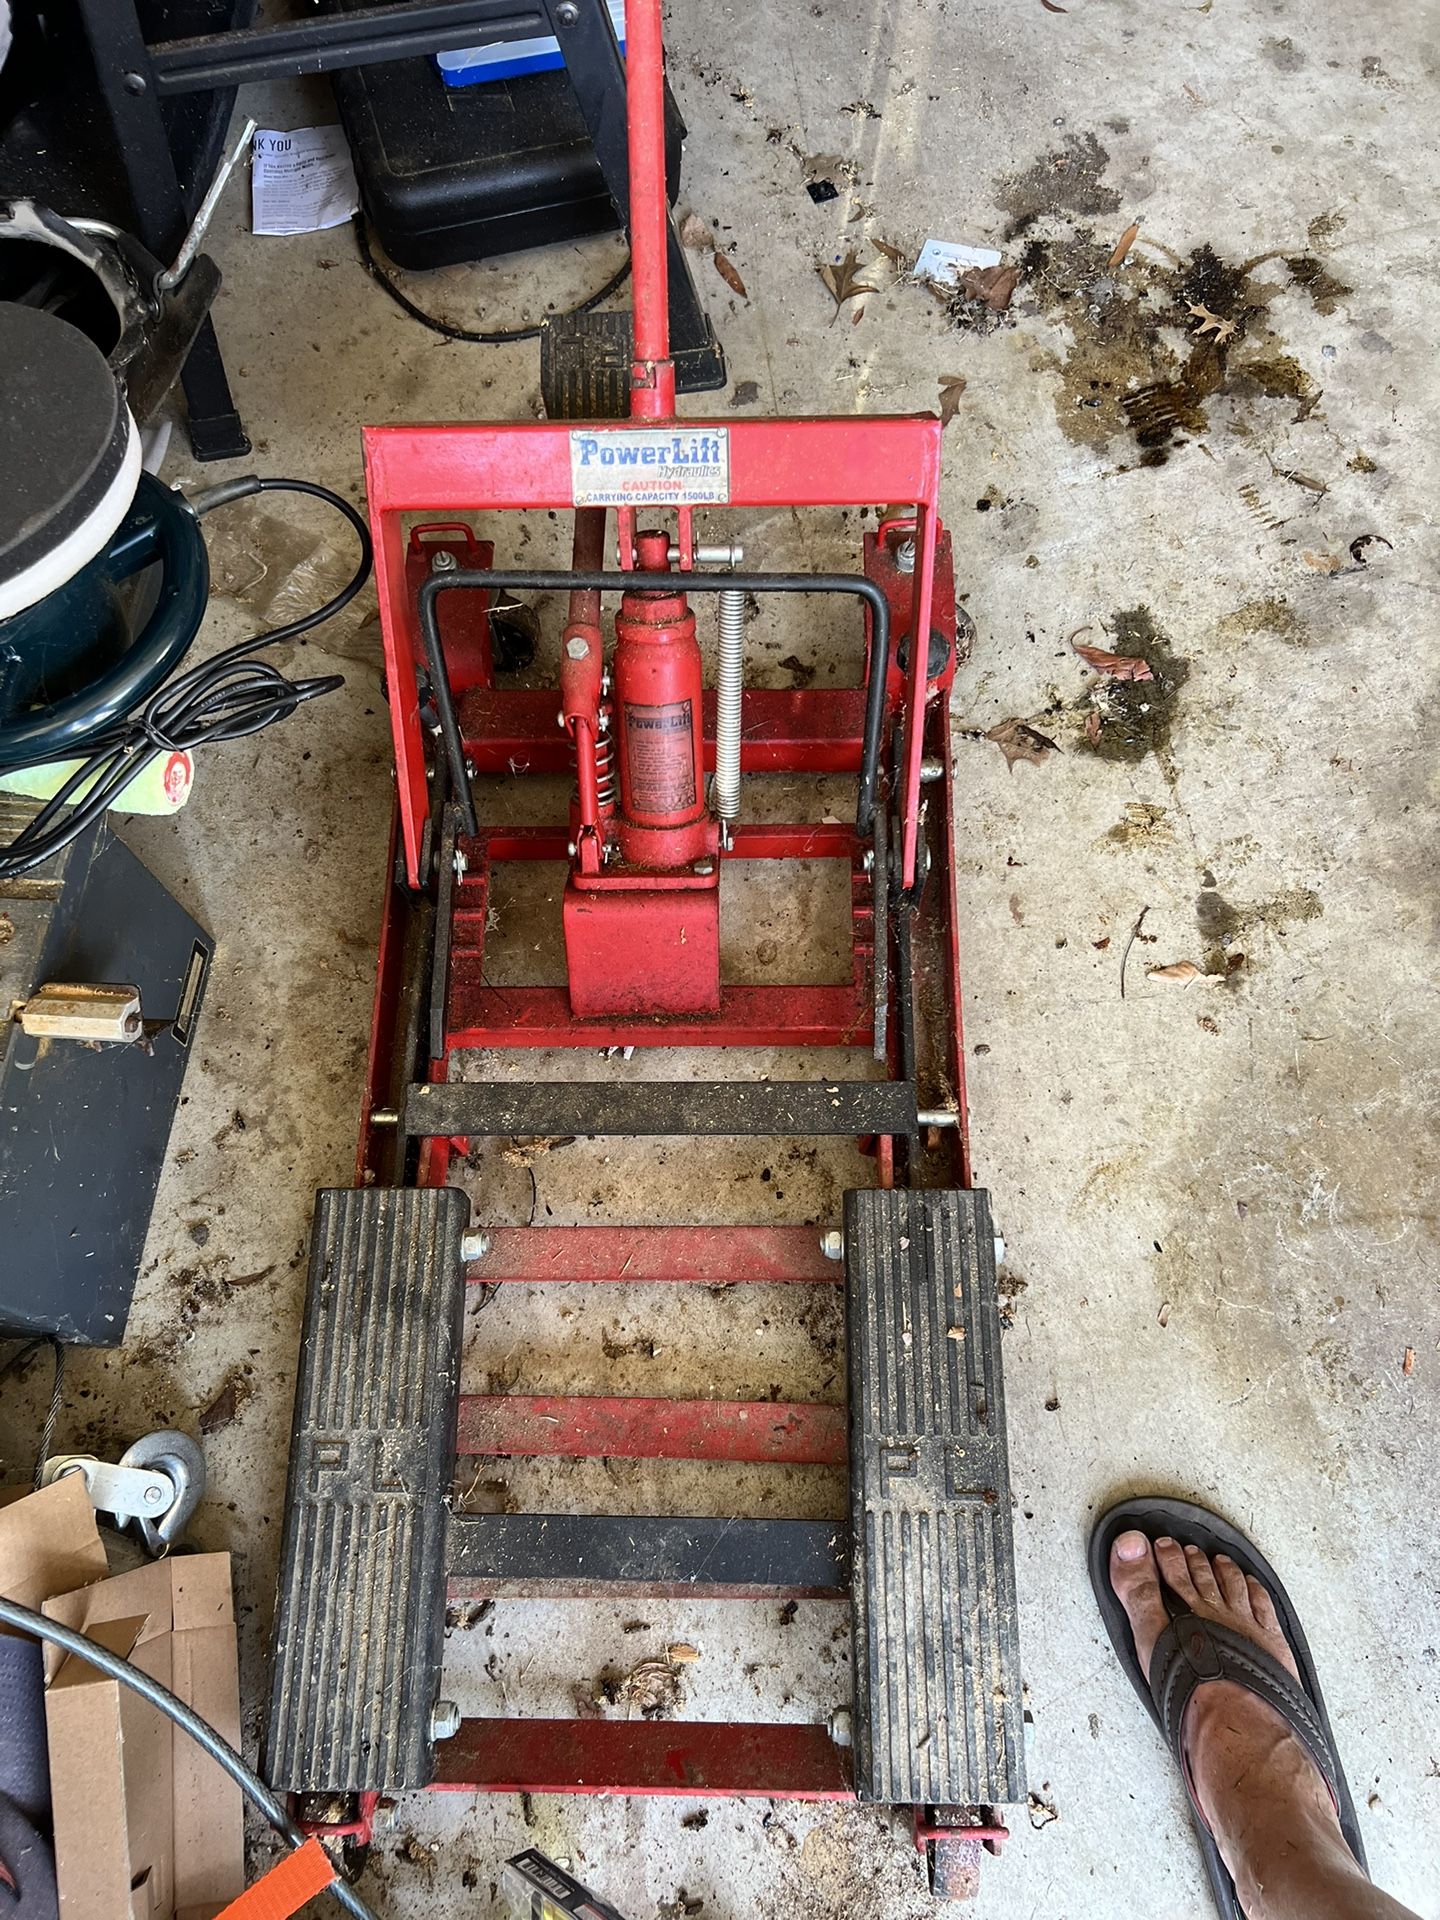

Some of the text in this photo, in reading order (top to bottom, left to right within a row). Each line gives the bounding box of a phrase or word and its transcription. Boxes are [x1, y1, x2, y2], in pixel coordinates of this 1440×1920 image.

[269, 139, 292, 152] YOU
[579, 437, 720, 466] PowerLift
[657, 465, 721, 479] Hydraulics
[621, 480, 682, 491] CAUTION
[586, 491, 715, 502] CARRYING CAPACITY 1500LB
